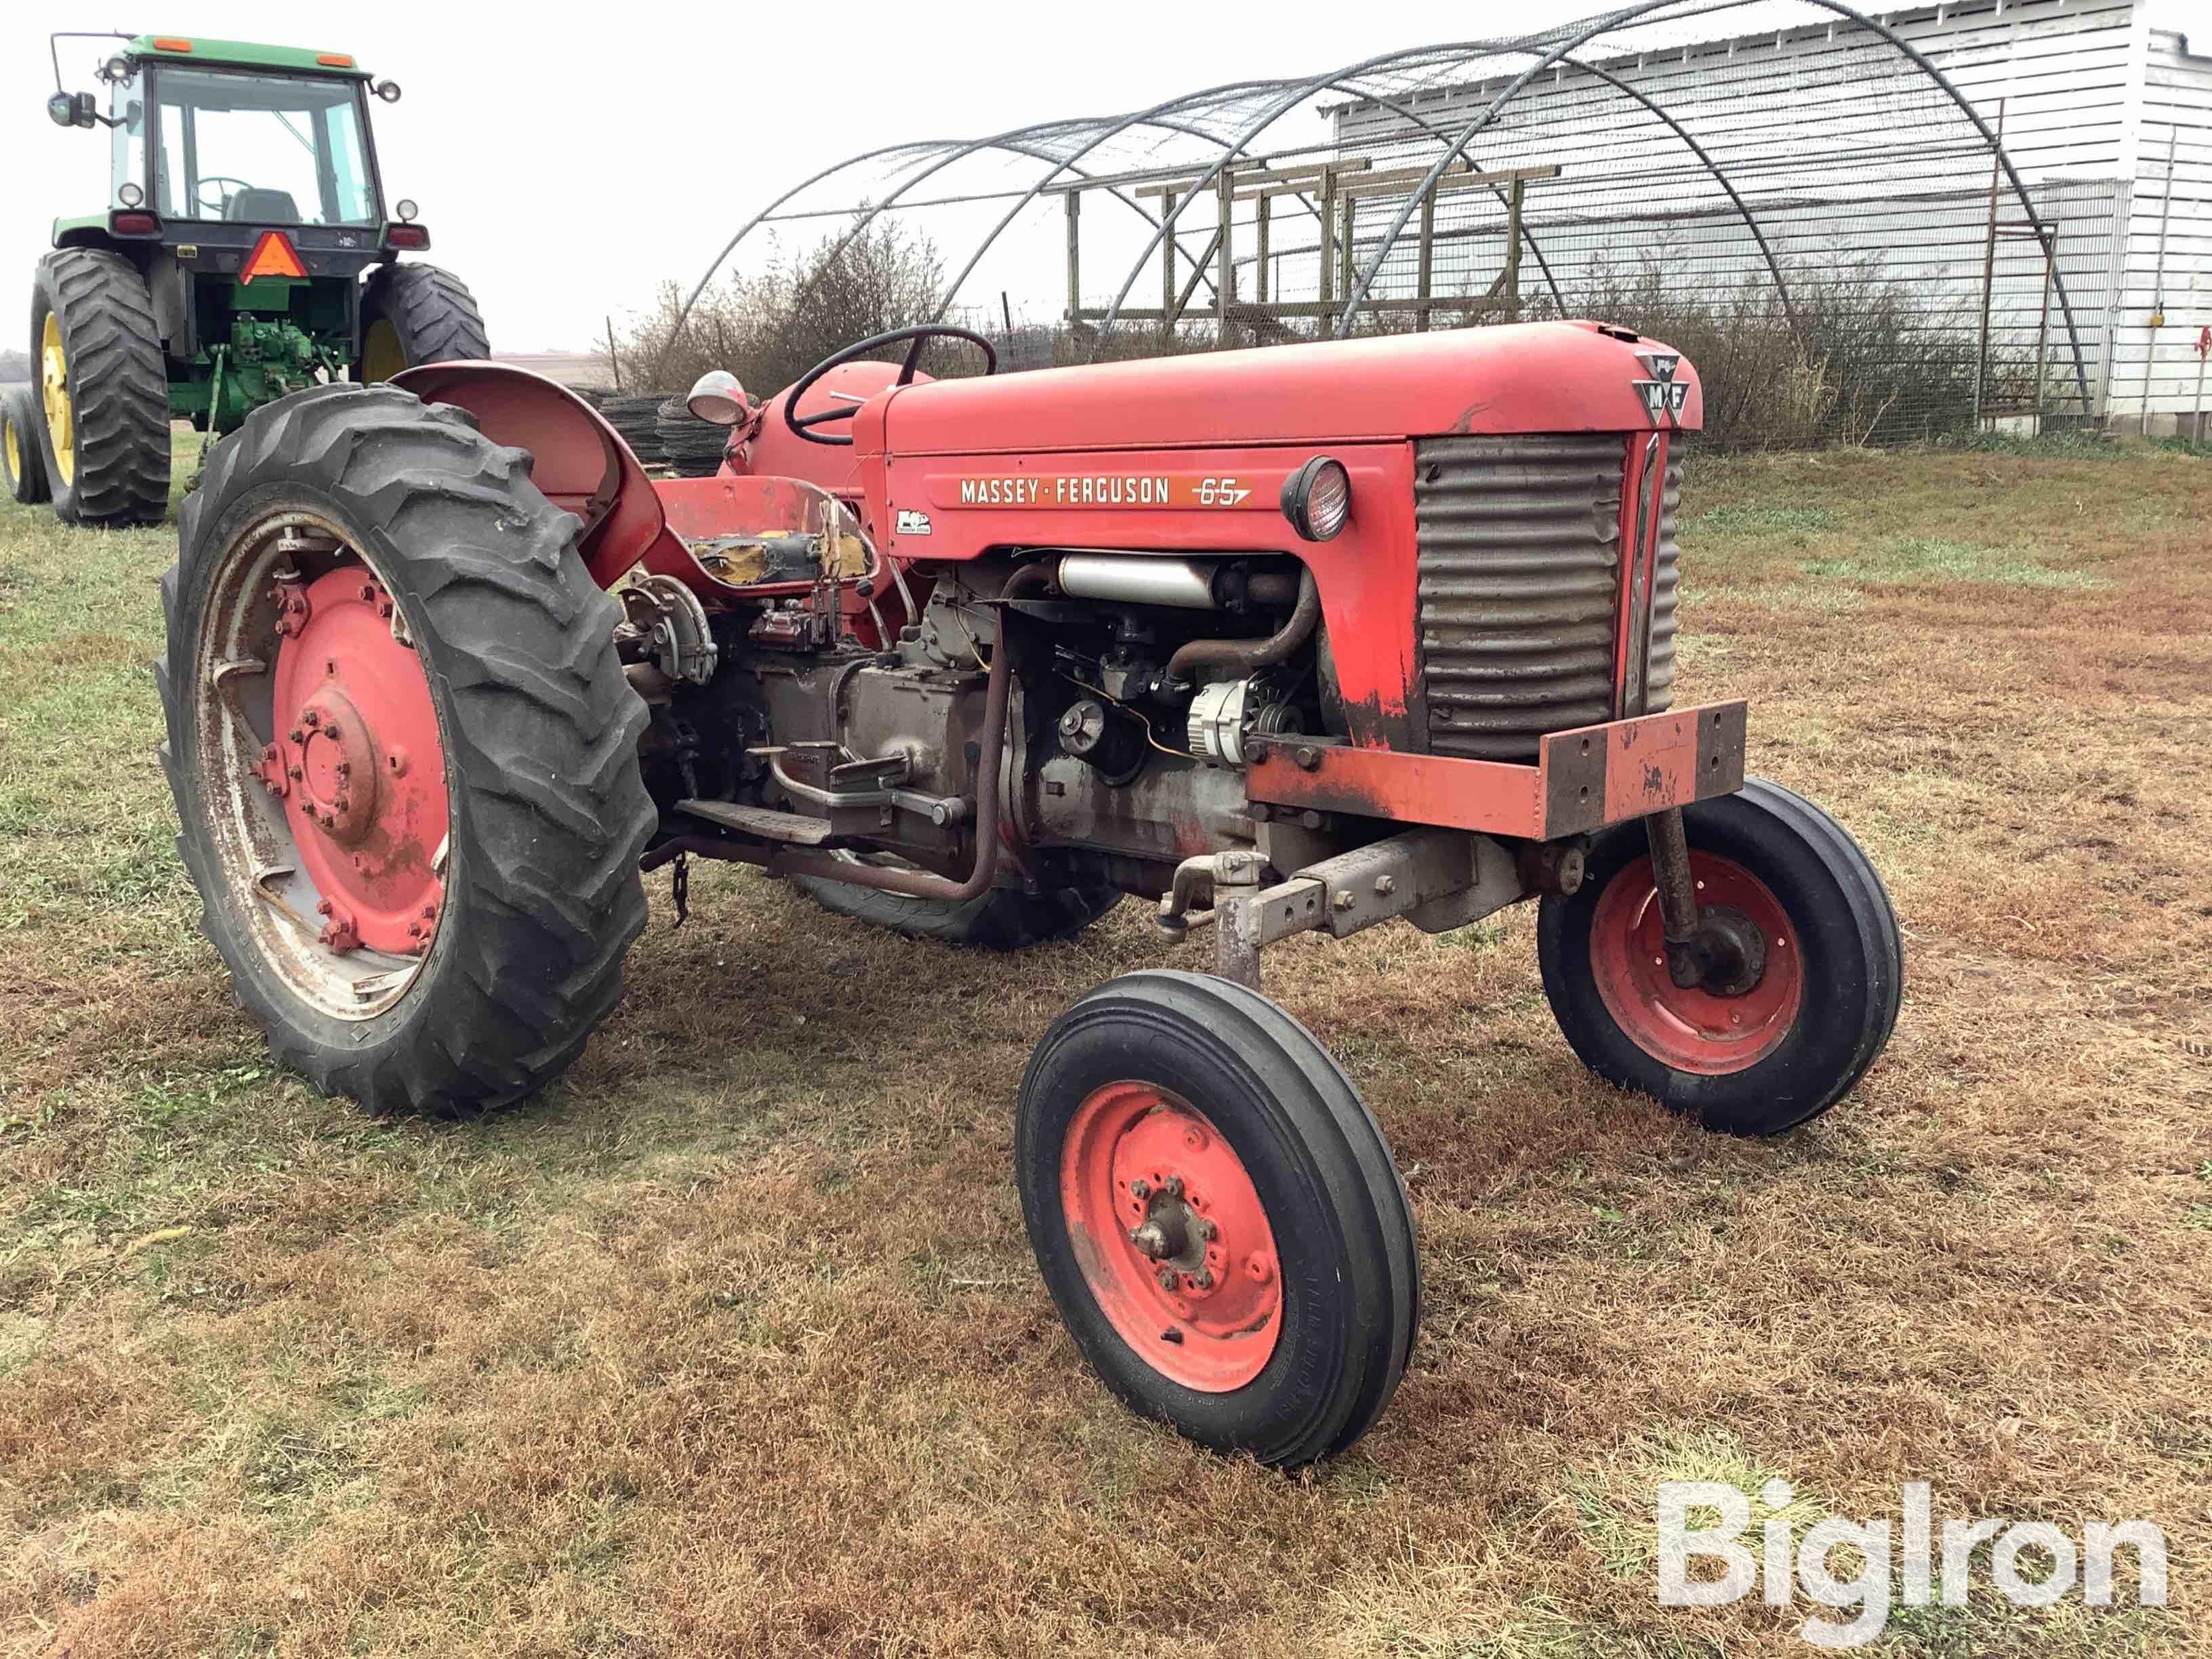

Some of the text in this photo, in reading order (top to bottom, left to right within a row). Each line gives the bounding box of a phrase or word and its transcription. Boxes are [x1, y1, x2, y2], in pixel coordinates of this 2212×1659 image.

[961, 477, 1236, 505] MASSEY FERGUSON 65
